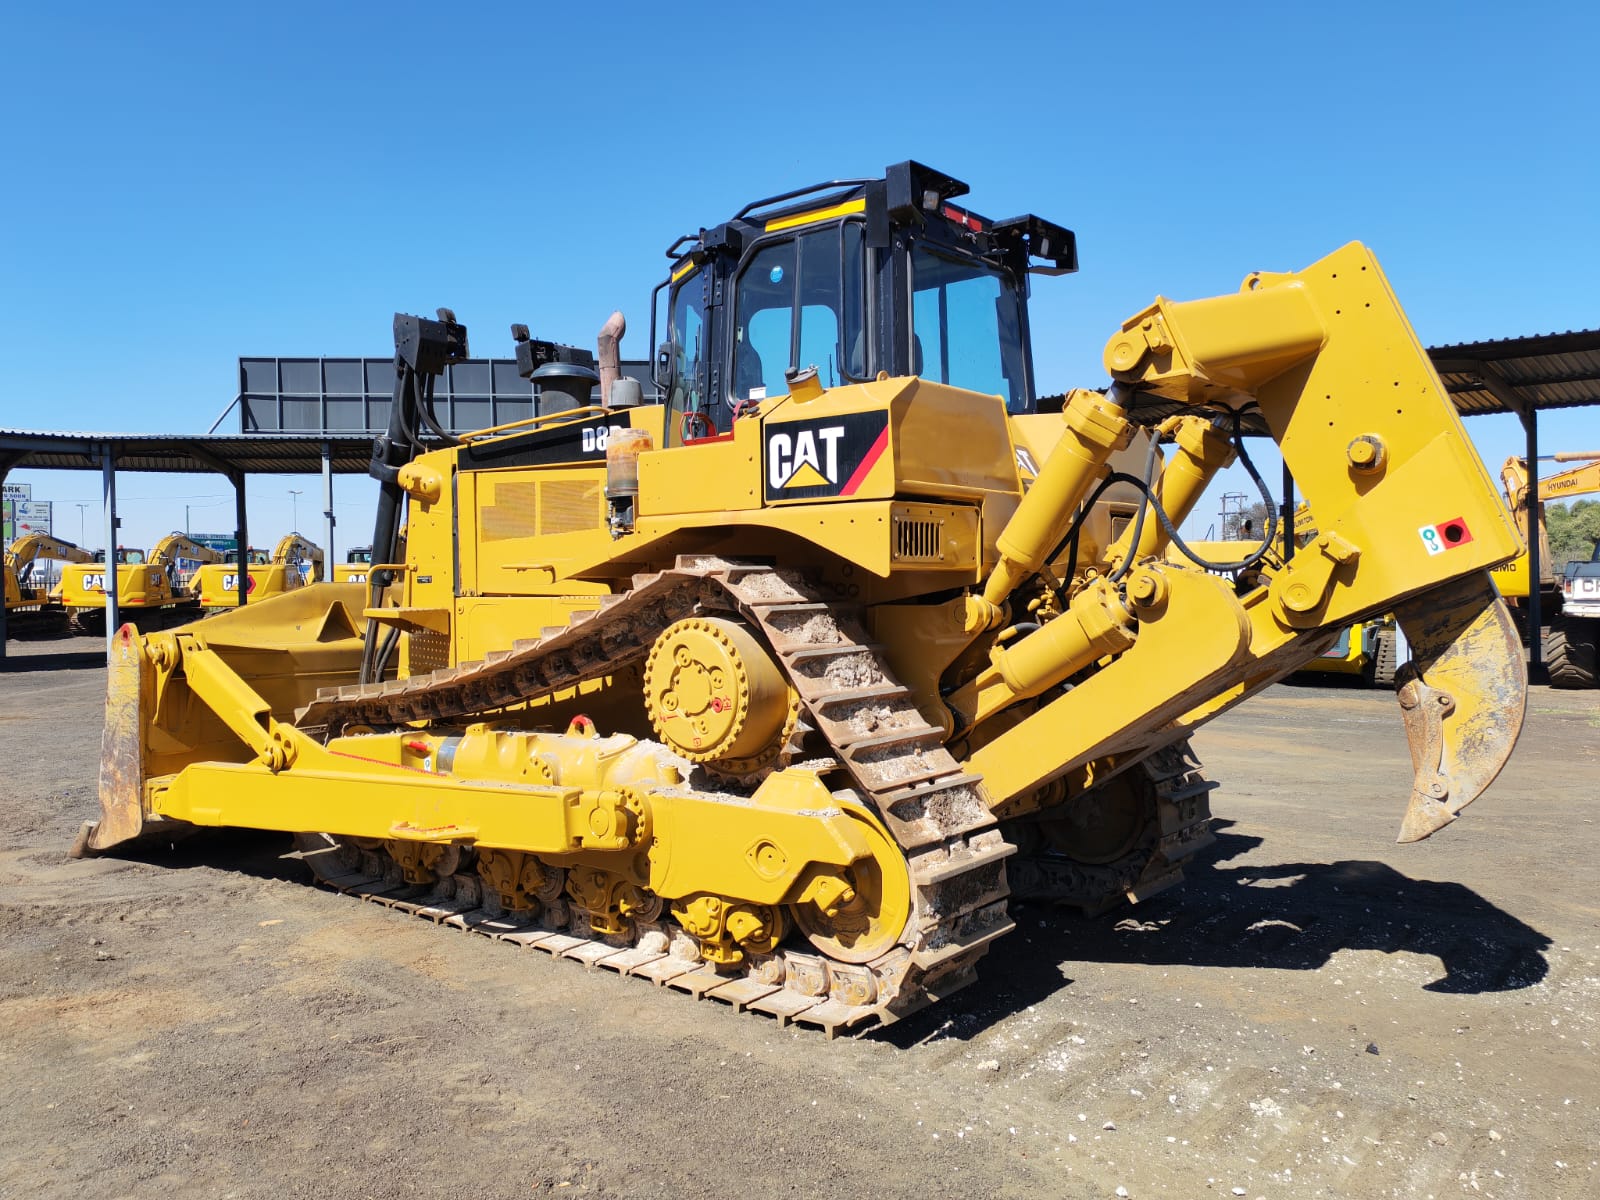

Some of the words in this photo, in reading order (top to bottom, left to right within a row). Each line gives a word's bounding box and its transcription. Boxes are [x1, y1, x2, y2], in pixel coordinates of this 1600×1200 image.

[582, 425, 623, 452] D8
[769, 426, 844, 489] CAT
[1547, 479, 1578, 491] HYUNDAI
[223, 574, 239, 591] CA
